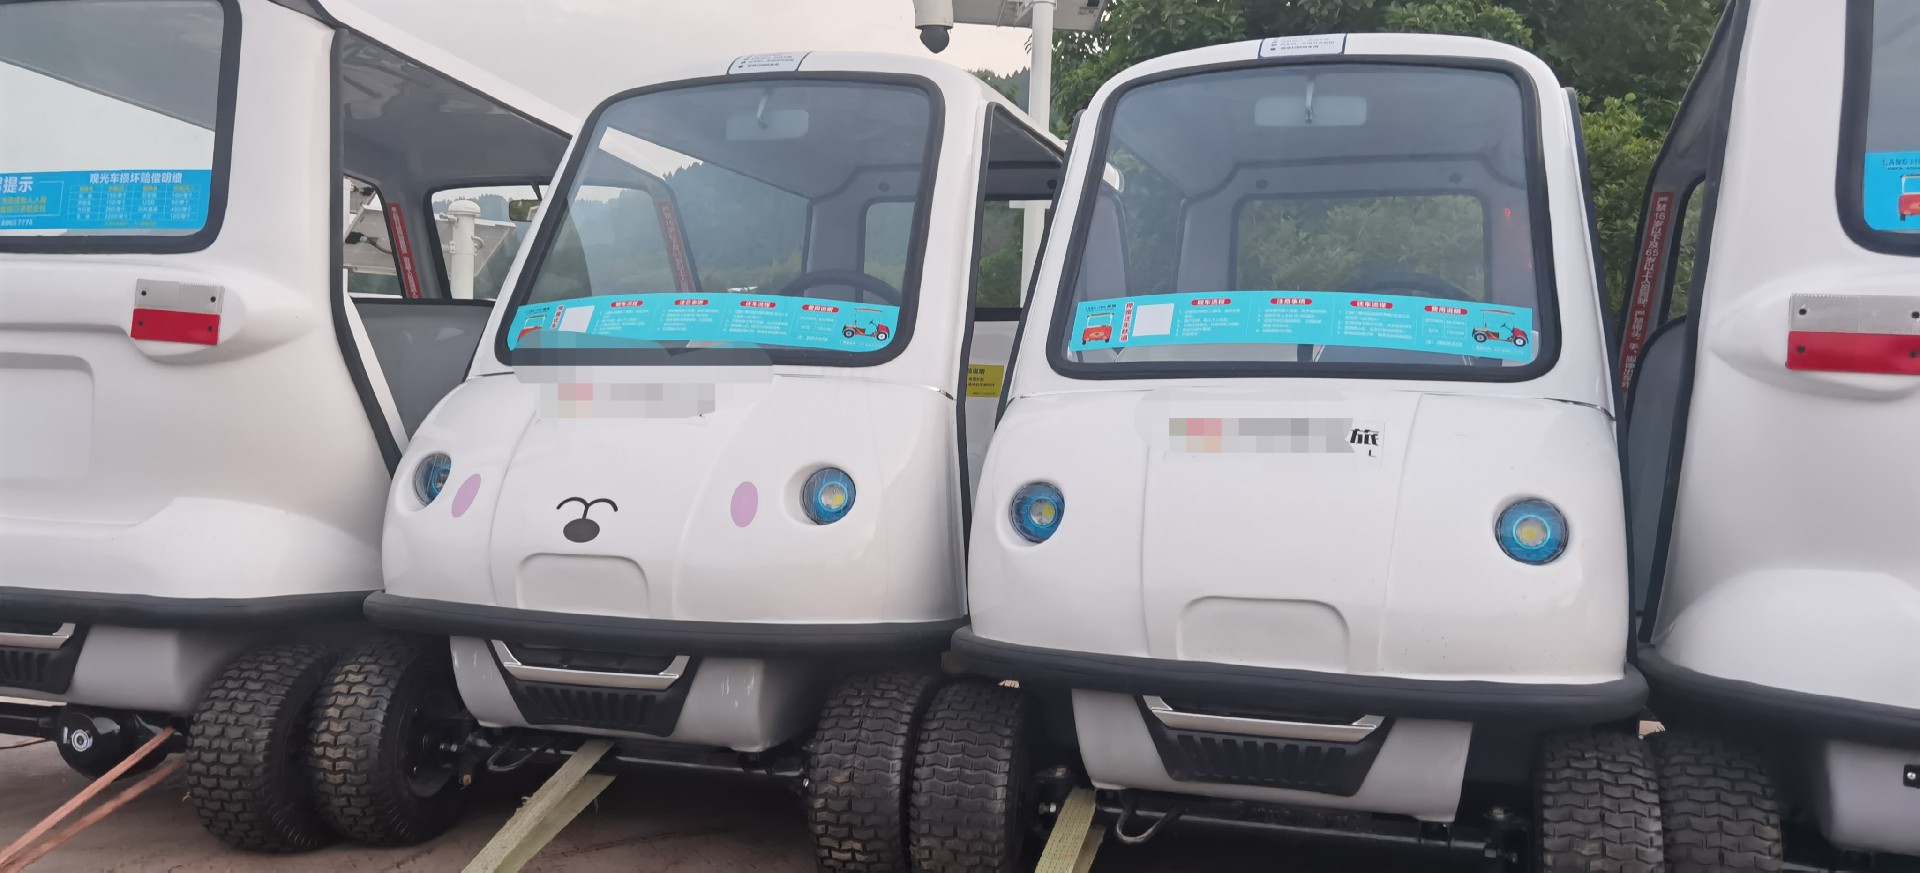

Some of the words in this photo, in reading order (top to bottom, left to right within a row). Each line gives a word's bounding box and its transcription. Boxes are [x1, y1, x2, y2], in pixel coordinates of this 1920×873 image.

[90, 172, 182, 184] 观光车损坏赔偿明细
